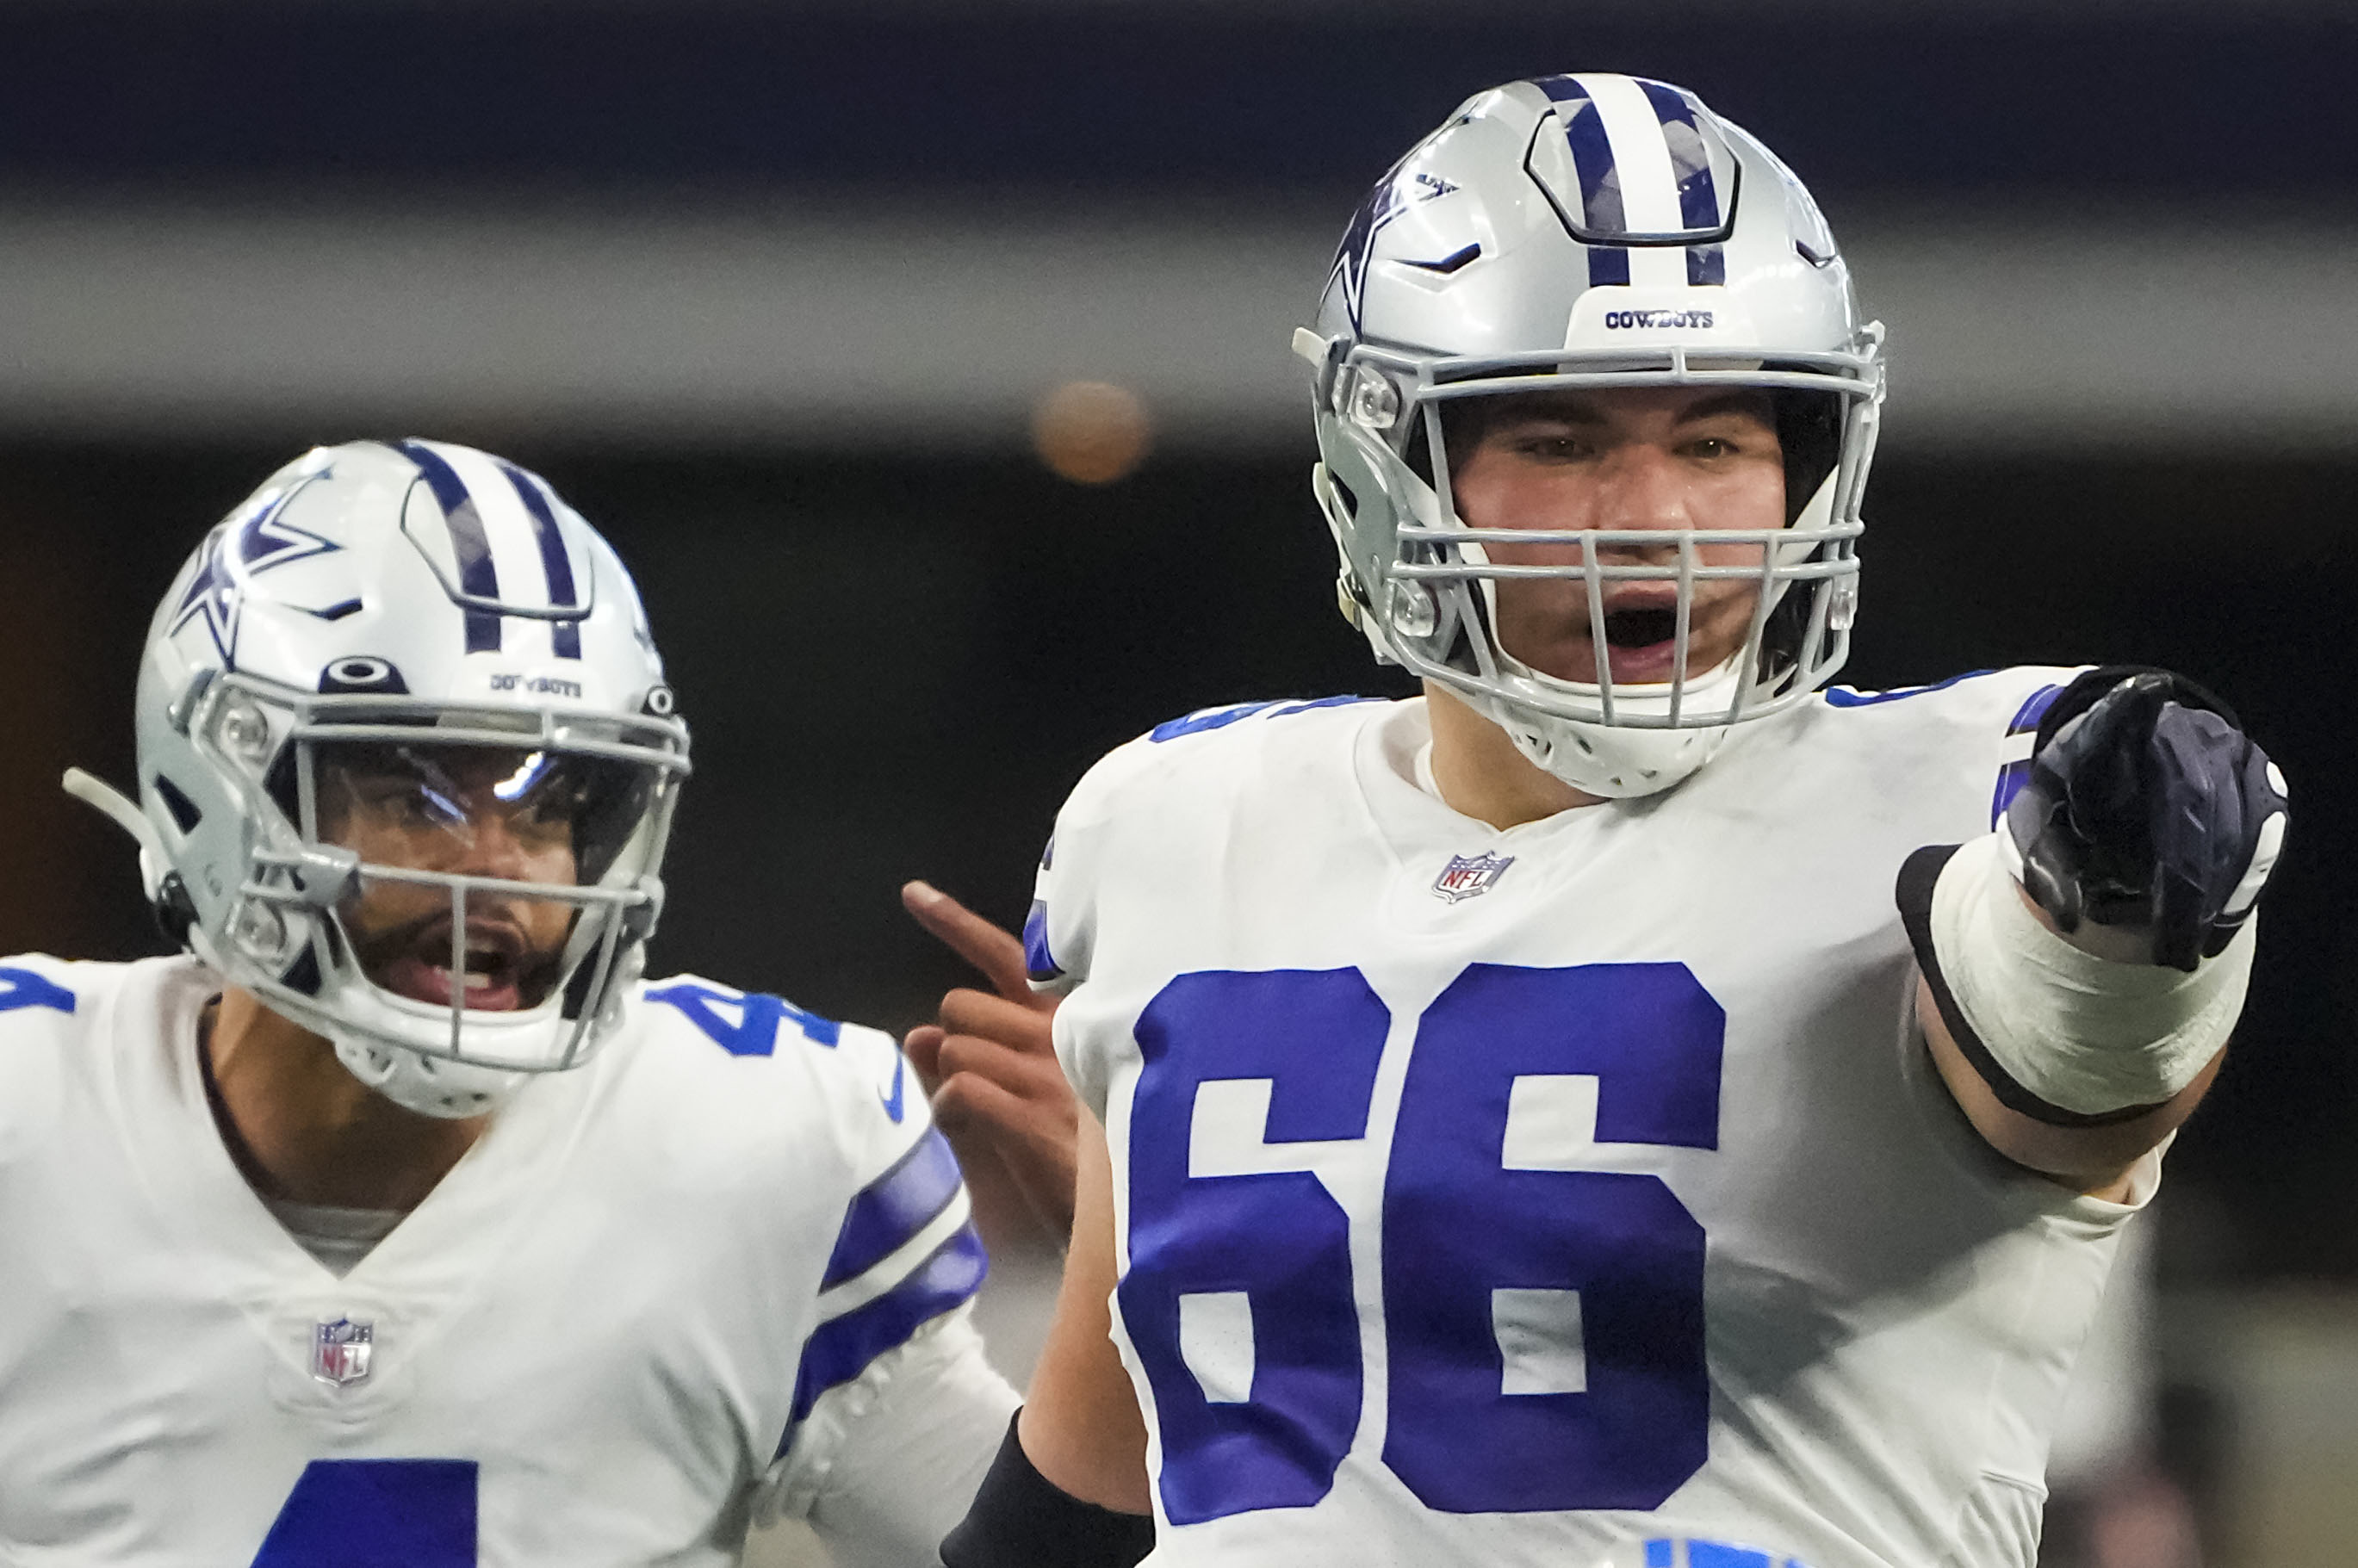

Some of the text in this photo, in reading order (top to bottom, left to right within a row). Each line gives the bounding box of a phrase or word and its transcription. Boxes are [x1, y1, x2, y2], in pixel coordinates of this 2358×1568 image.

[1605, 310, 1714, 329] COWBOYS
[1442, 871, 1485, 889] NFL
[1118, 962, 1726, 1526] 66
[321, 1347, 363, 1377] NFL
